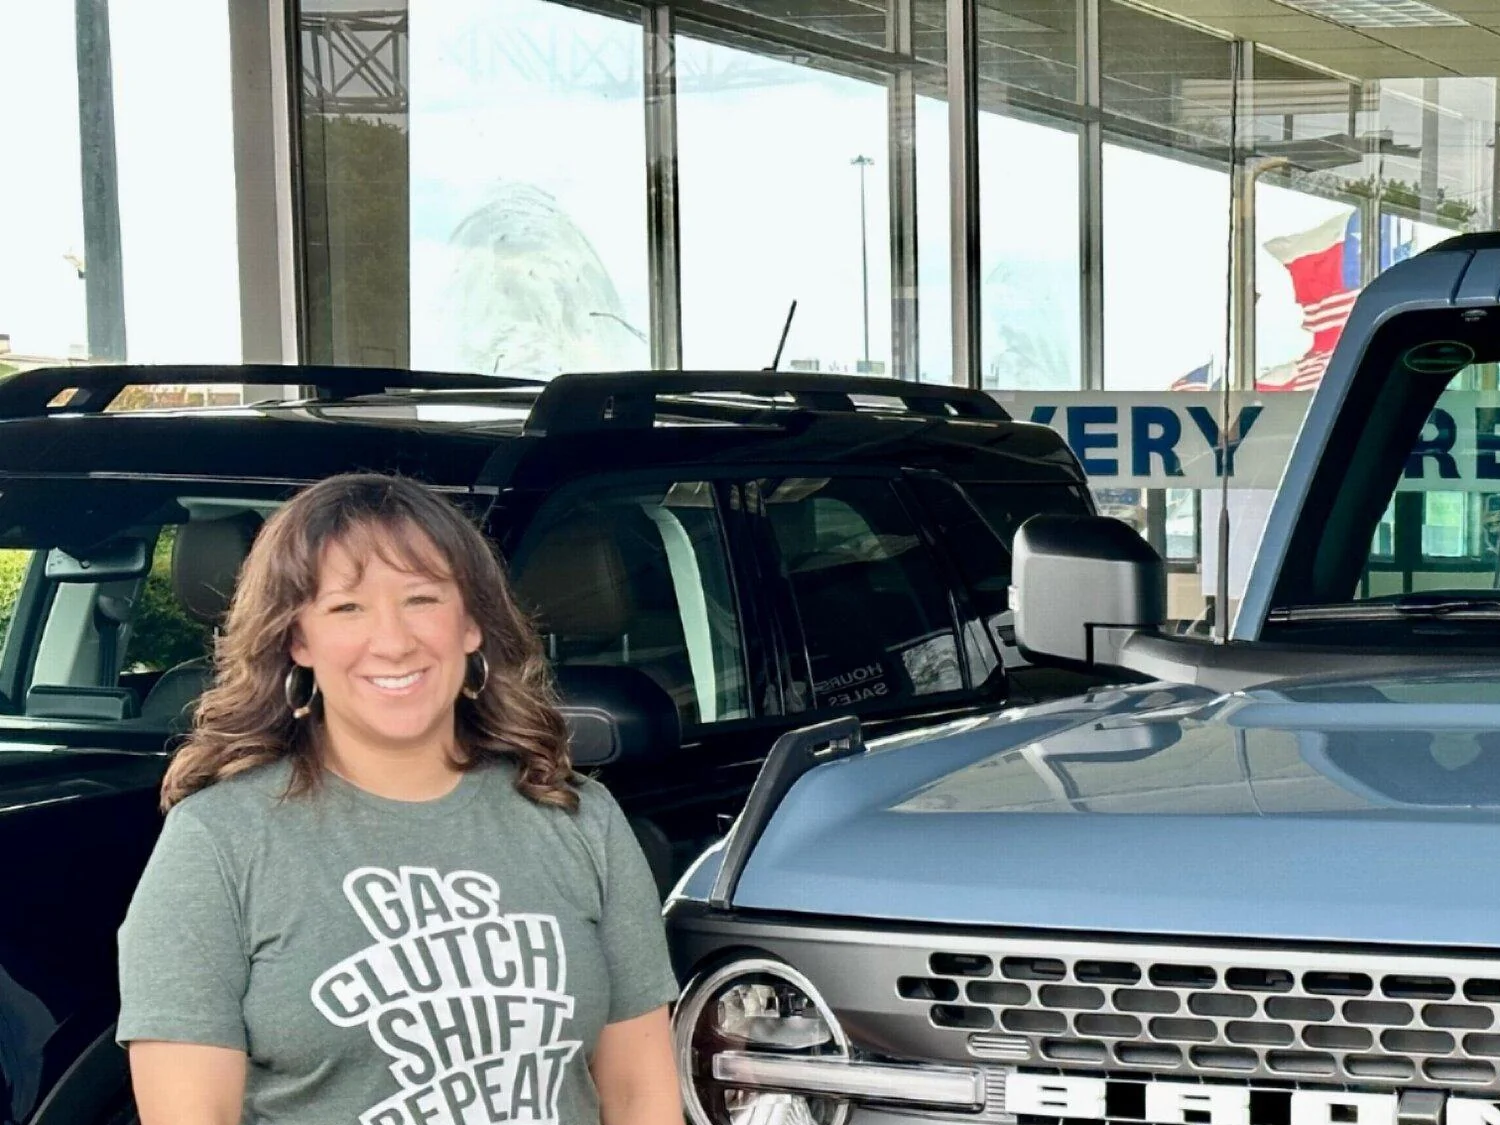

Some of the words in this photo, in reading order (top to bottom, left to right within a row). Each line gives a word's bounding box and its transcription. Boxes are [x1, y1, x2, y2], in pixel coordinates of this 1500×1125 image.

[1032, 405, 1265, 477] ERY
[350, 871, 494, 941] GAS
[317, 919, 560, 1021] CLUTCH
[375, 993, 570, 1086] SHIFT
